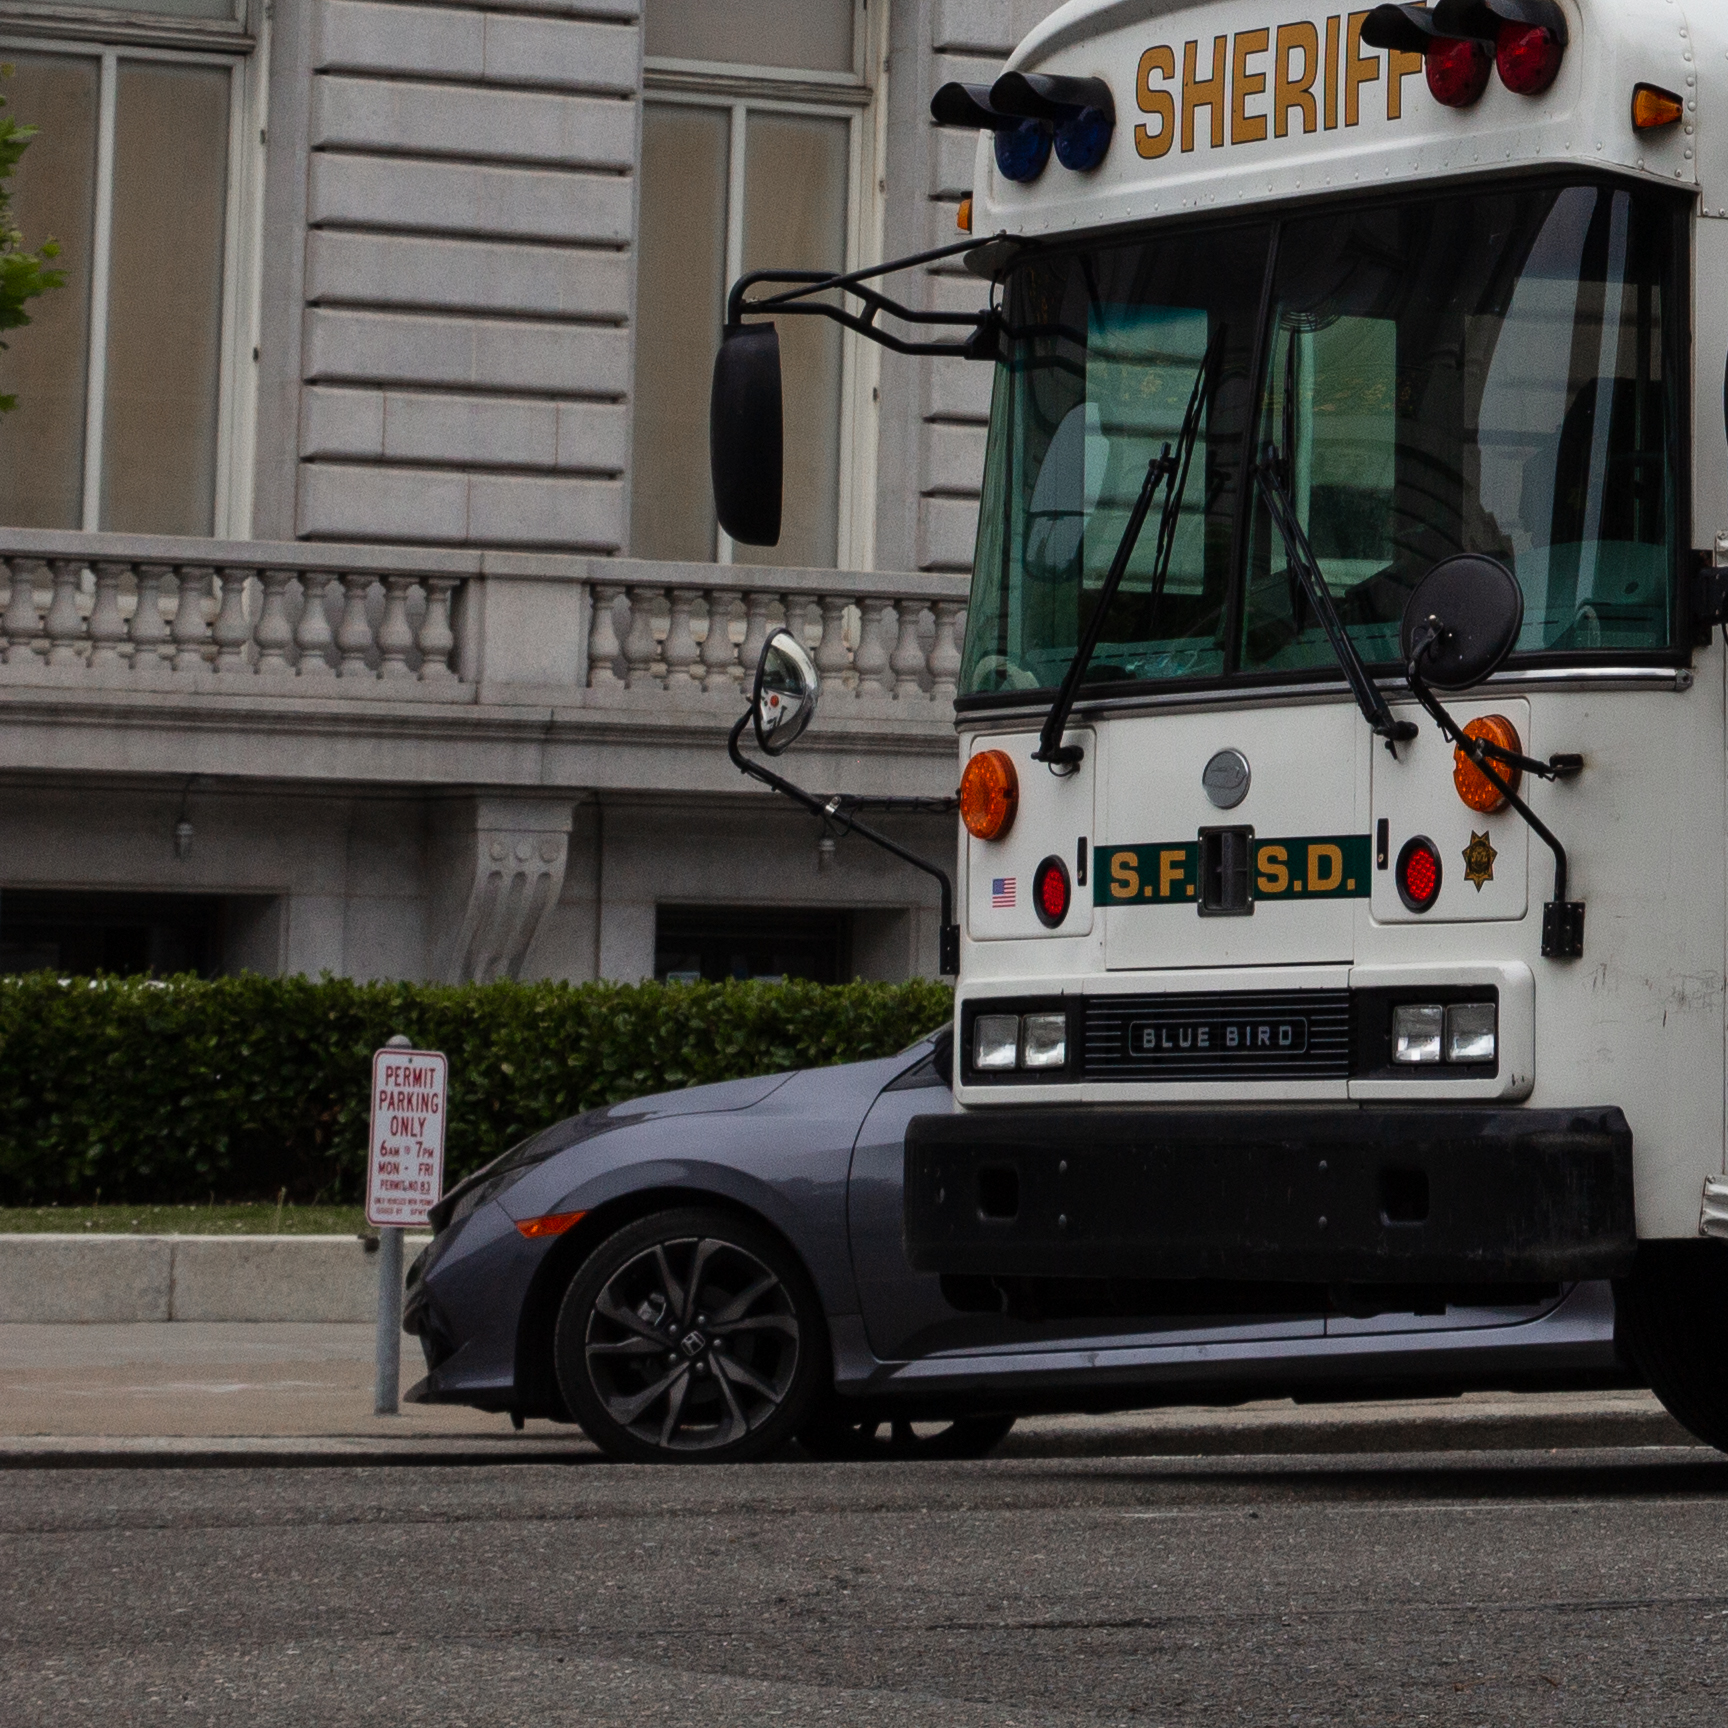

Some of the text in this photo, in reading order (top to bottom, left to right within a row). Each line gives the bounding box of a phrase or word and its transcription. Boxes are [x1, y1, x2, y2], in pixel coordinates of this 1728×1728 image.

[1133, 0, 1428, 160] SHERIFF
[1142, 1024, 1294, 1048] BLUE BIRD
[385, 1066, 436, 1089] PERMIT
[378, 1090, 439, 1114] PARKING
[390, 1115, 426, 1138] ONLY
[380, 1140, 400, 1158] 6AM
[415, 1141, 434, 1159] 7PM
[378, 1161, 400, 1176] MON
[418, 1162, 434, 1177] FRI
